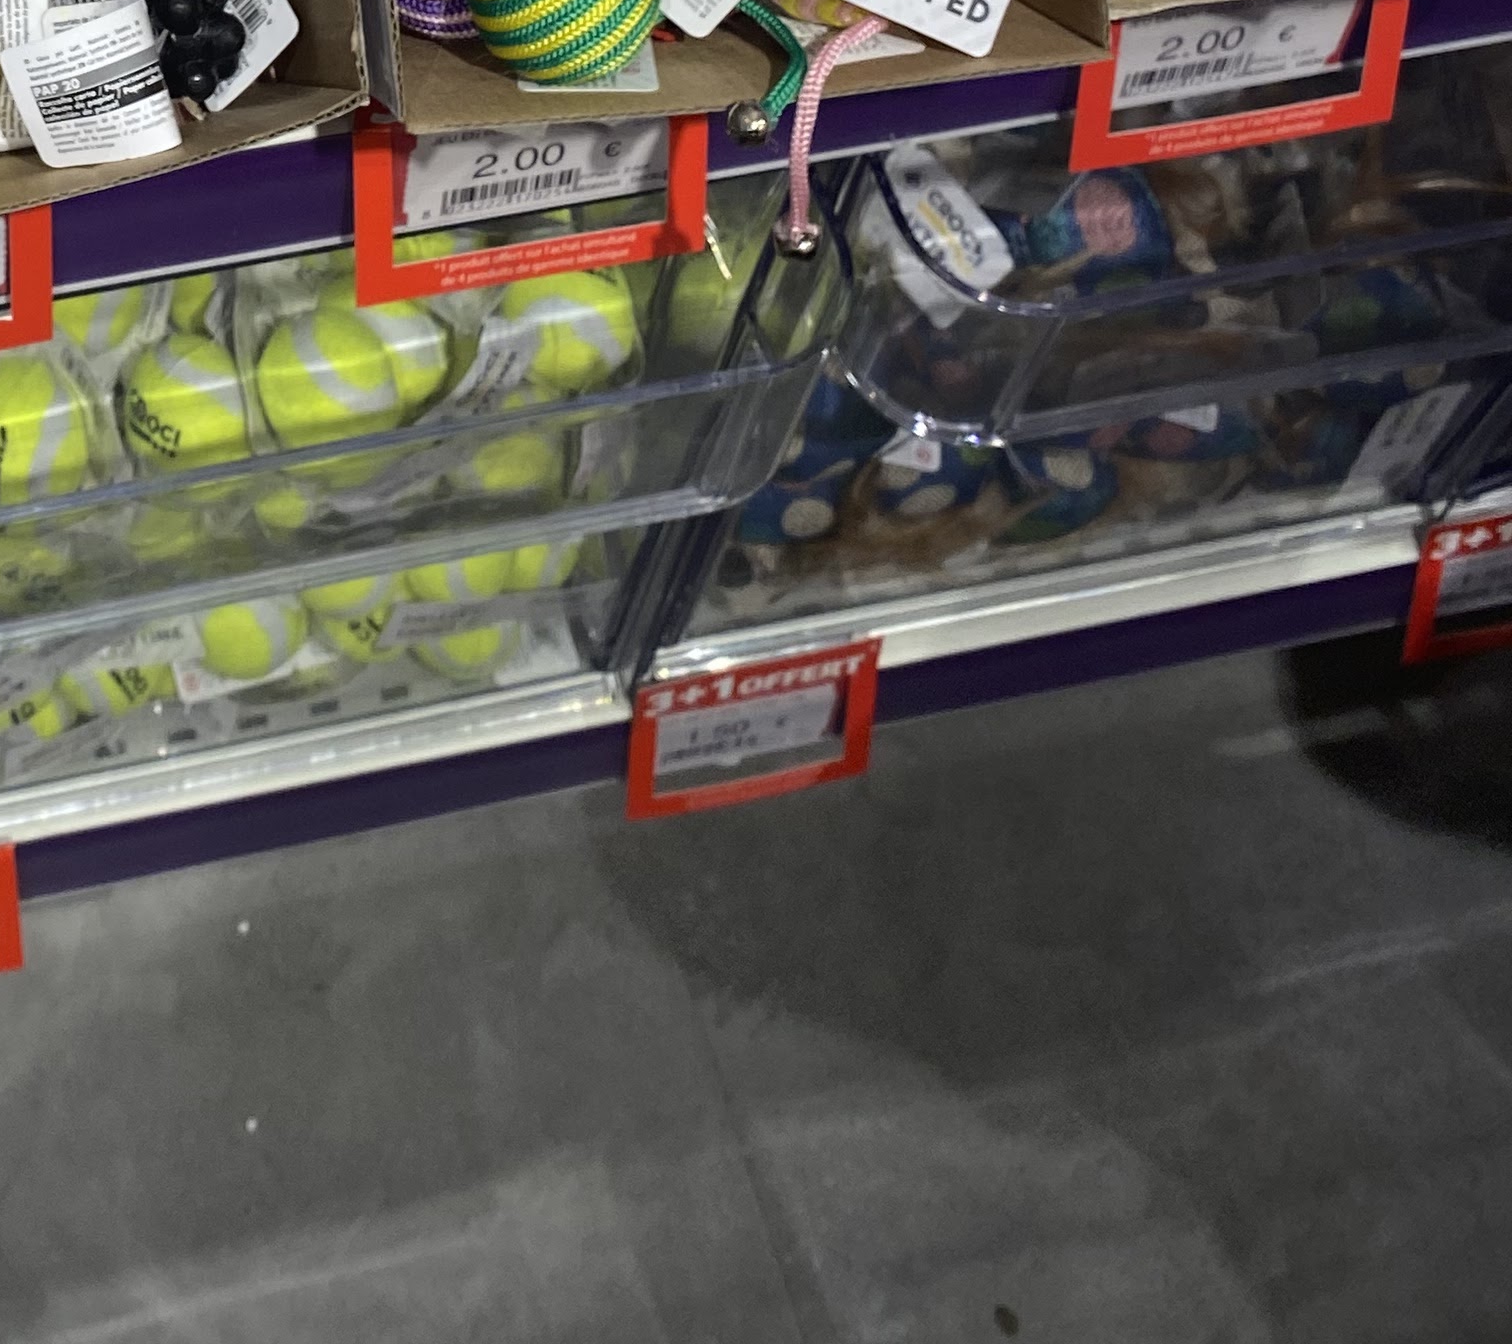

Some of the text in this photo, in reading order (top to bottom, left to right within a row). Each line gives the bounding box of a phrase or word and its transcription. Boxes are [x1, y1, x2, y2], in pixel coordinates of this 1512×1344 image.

[1156, 25, 1246, 62] 2.00
[472, 140, 621, 178] 2.00 €
